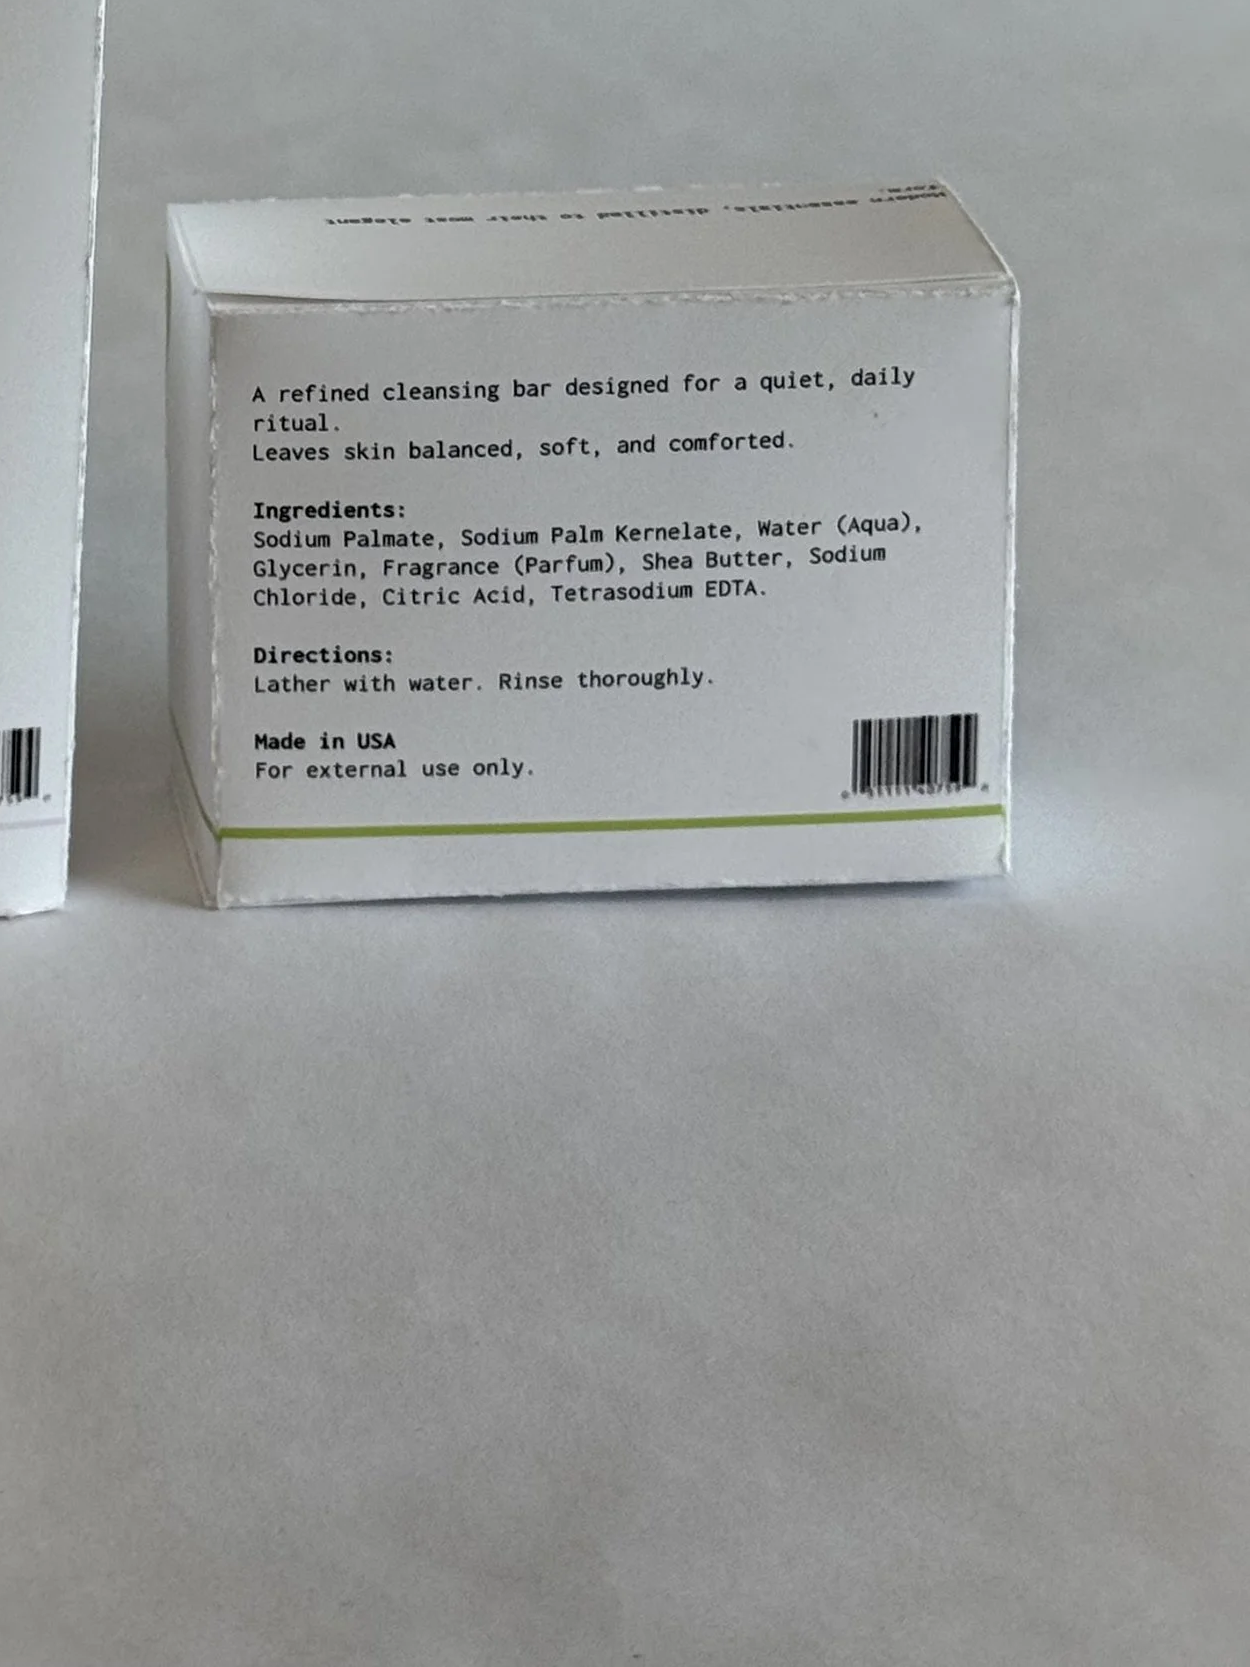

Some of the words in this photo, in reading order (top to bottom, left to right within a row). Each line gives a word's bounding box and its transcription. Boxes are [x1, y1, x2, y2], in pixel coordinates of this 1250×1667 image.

[252, 386, 266, 403] A
[280, 382, 369, 403] refined
[383, 381, 500, 403] cleansing
[513, 379, 552, 397] bar
[565, 374, 669, 399] designed
[683, 373, 721, 392] for
[734, 377, 747, 391] a
[760, 371, 834, 394] quiet,
[851, 366, 915, 389] daily
[254, 413, 339, 432] ritual.
[253, 444, 330, 462] Leaves
[344, 442, 395, 461] skin
[409, 439, 522, 461] balanced,
[539, 437, 600, 458] soft,
[617, 434, 656, 454] and
[669, 430, 794, 452] comforted.
[253, 500, 405, 523] Ingredients:
[254, 530, 331, 549] Sodium
[343, 529, 444, 551] Palmate,
[461, 527, 539, 547] Sodium
[551, 525, 604, 545] Palm
[615, 521, 741, 543] Kernelate,
[757, 519, 822, 537] Water
[837, 510, 921, 537] (Aqua),
[253, 558, 366, 581] Glycerin,
[383, 559, 500, 580] Fragrance
[515, 552, 625, 577] (Parfum),
[642, 551, 693, 571] Shea
[706, 550, 792, 569] Butter,
[809, 545, 886, 564] Sodium
[254, 587, 366, 609] Chloride,
[383, 586, 460, 606] Citric
[473, 584, 534, 607] Acid,
[550, 581, 694, 602] Tetrasodium
[705, 579, 766, 598] EDTA.
[254, 645, 392, 665] Directions:
[255, 674, 331, 694] Lather
[343, 673, 395, 693] with
[409, 675, 482, 692] water.
[499, 672, 563, 691] Rinse
[577, 666, 713, 690] thoroughly.
[254, 731, 306, 750] Made
[320, 731, 345, 750] in
[357, 732, 396, 750] USA
